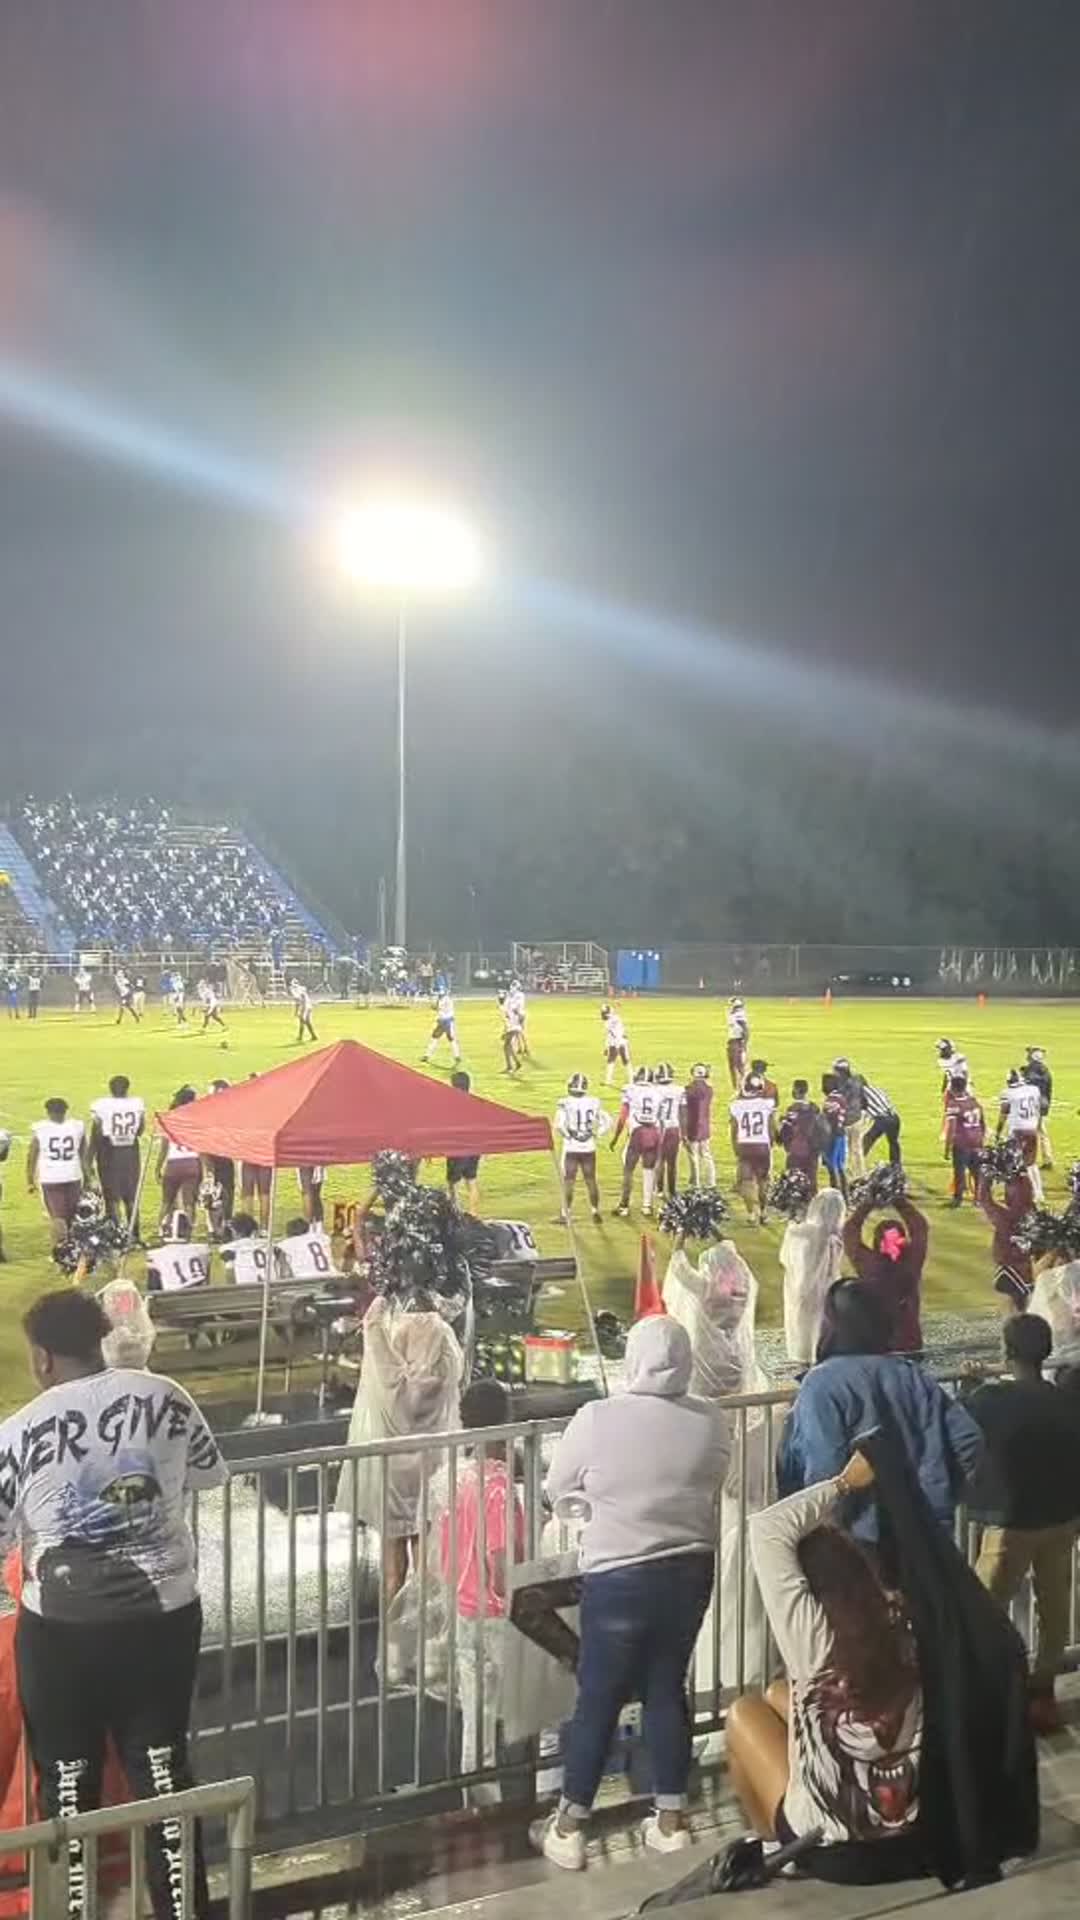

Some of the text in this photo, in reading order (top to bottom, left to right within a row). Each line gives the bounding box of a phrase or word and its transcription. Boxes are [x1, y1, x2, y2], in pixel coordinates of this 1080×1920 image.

[111, 1111, 136, 1136] 62
[741, 1111, 763, 1136] 42
[48, 1136, 74, 1160] 52
[308, 1242, 328, 1272] 8
[97, 1392, 192, 1457] GIVE
